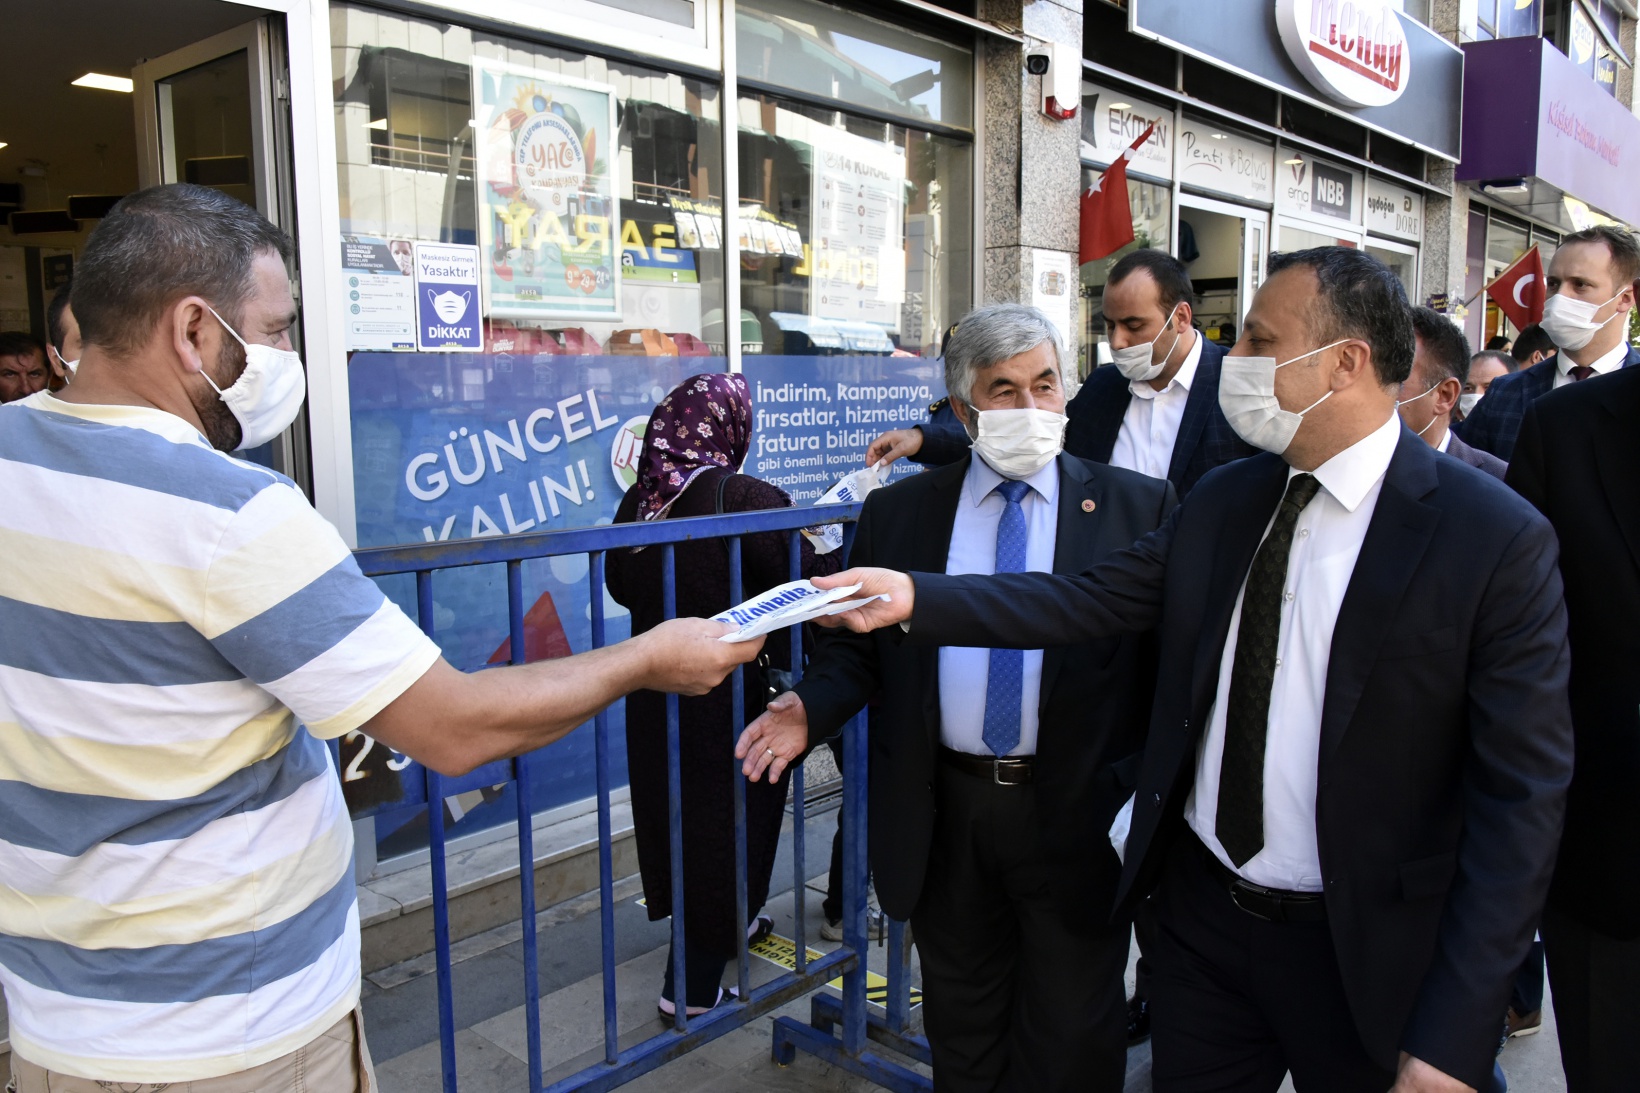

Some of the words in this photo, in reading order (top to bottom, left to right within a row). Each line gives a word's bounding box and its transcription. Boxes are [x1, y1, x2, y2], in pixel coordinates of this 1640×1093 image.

[1181, 131, 1223, 165] Penti
[1317, 176, 1344, 207] NBB
[1395, 213, 1418, 235] DORE
[421, 253, 450, 262] Maskesiz
[421, 264, 468, 278] Yasaktır
[428, 324, 472, 339] DİKKAT
[756, 381, 831, 403] İndirim,
[756, 407, 840, 432] fırsatlar,
[845, 404, 929, 424] hizmetler,
[405, 388, 619, 501] GÜNCEL
[756, 433, 819, 458] fatura
[757, 457, 780, 473] gibi
[784, 455, 823, 469] önemli
[759, 470, 829, 488] laşabilmek
[832, 471, 845, 480] ve
[893, 463, 925, 474] hizme
